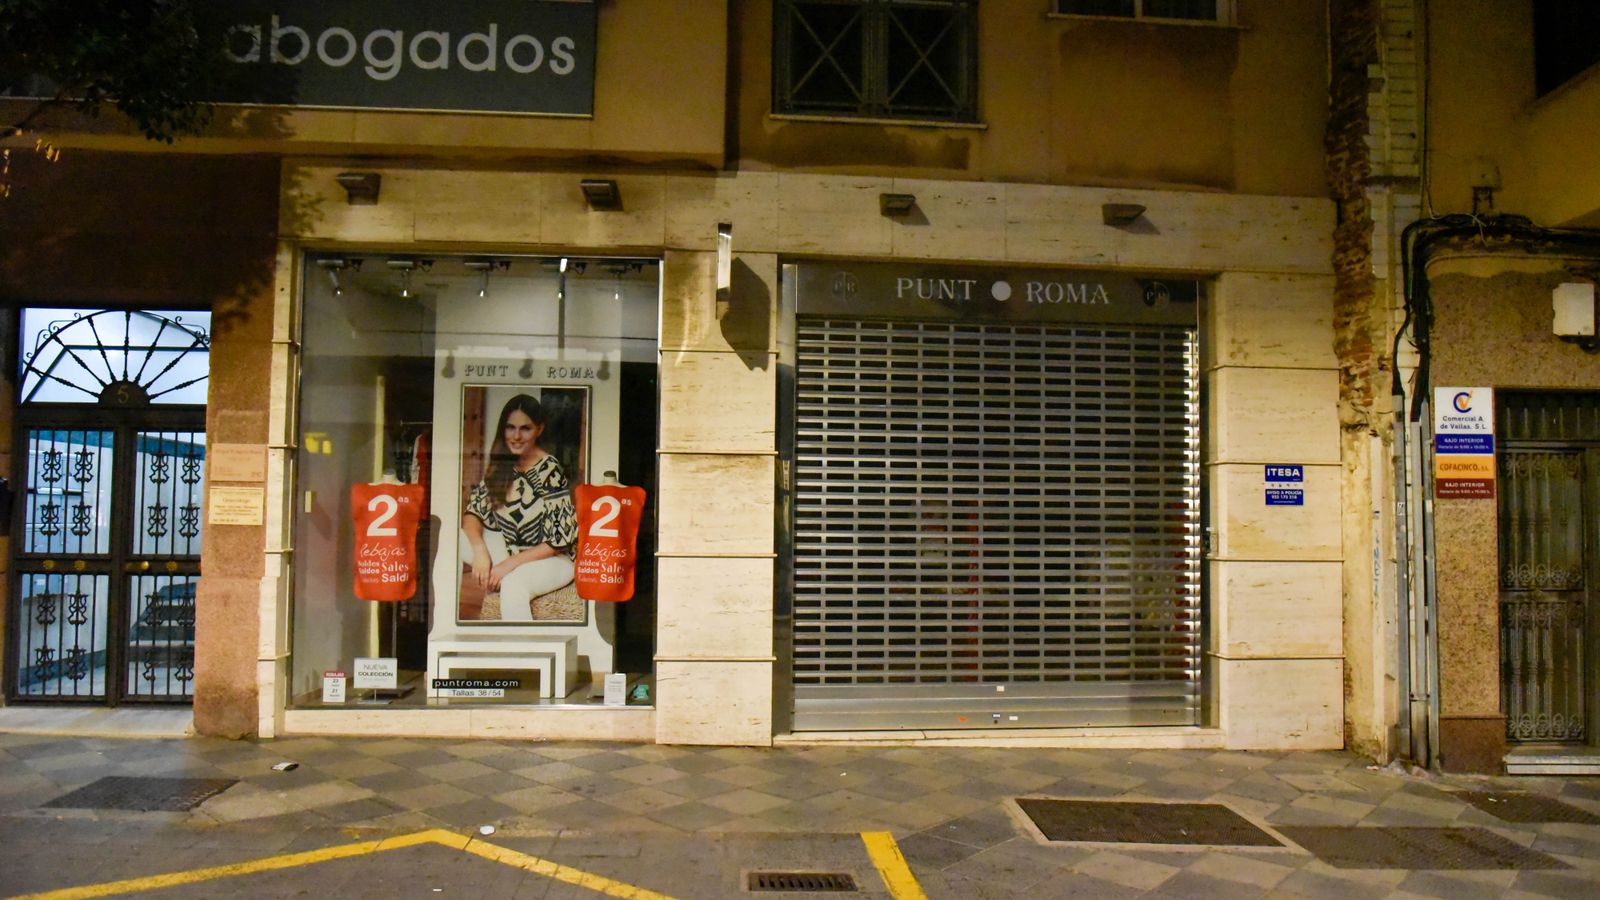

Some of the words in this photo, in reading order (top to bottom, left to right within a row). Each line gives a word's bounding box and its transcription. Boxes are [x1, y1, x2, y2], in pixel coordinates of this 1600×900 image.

[225, 14, 576, 81] abogados
[896, 277, 977, 301] PUNT
[1026, 281, 1110, 305] ROMA
[464, 364, 509, 377] PUNT
[547, 366, 595, 379] ROMA
[117, 385, 129, 404] 5
[1267, 468, 1301, 477] ITESA
[381, 561, 409, 572] Sales
[381, 573, 409, 583] Saldi
[434, 679, 519, 689] puntroma.com
[452, 689, 475, 697] Tallas
